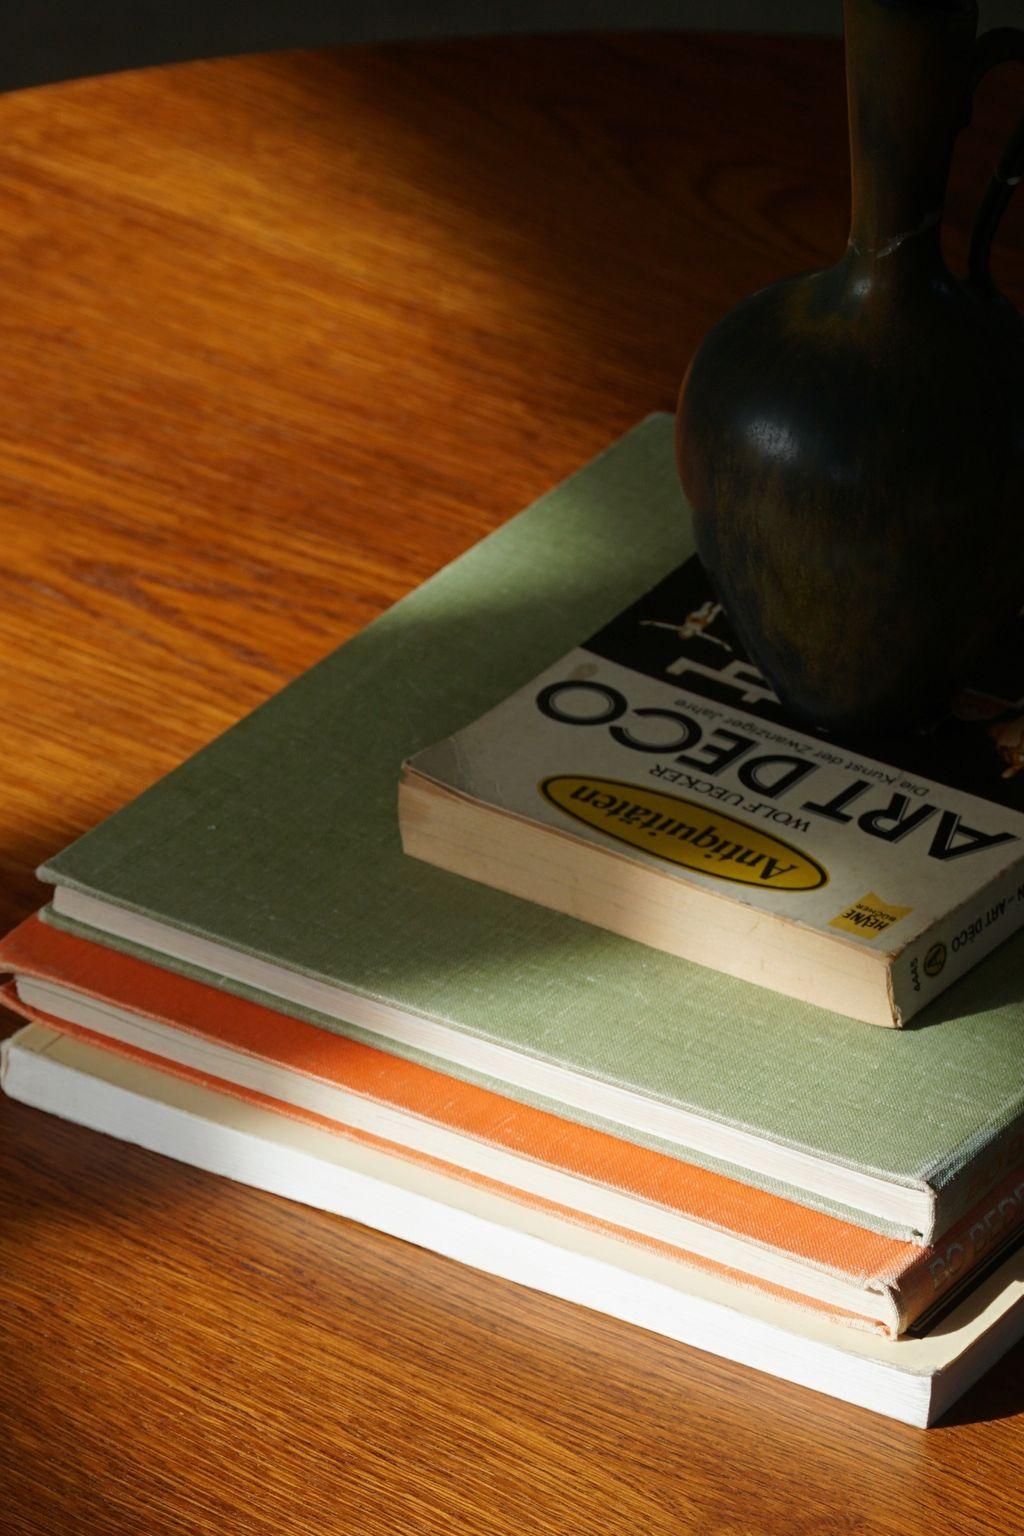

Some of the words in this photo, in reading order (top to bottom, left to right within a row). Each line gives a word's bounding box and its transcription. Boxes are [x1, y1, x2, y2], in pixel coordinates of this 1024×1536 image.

[673, 699, 722, 719] Jahre
[536, 679, 818, 799] DECO
[722, 717, 813, 755] Zwanziger
[814, 750, 844, 767] der
[845, 761, 894, 785] Kunst
[649, 764, 744, 807] UECKER
[899, 780, 931, 797] Die
[569, 785, 797, 880] Antiquitäten
[742, 801, 810, 833] WOLF
[802, 780, 1019, 860] ART
[842, 908, 890, 931] HEYNE
[985, 897, 1006, 928] ART
